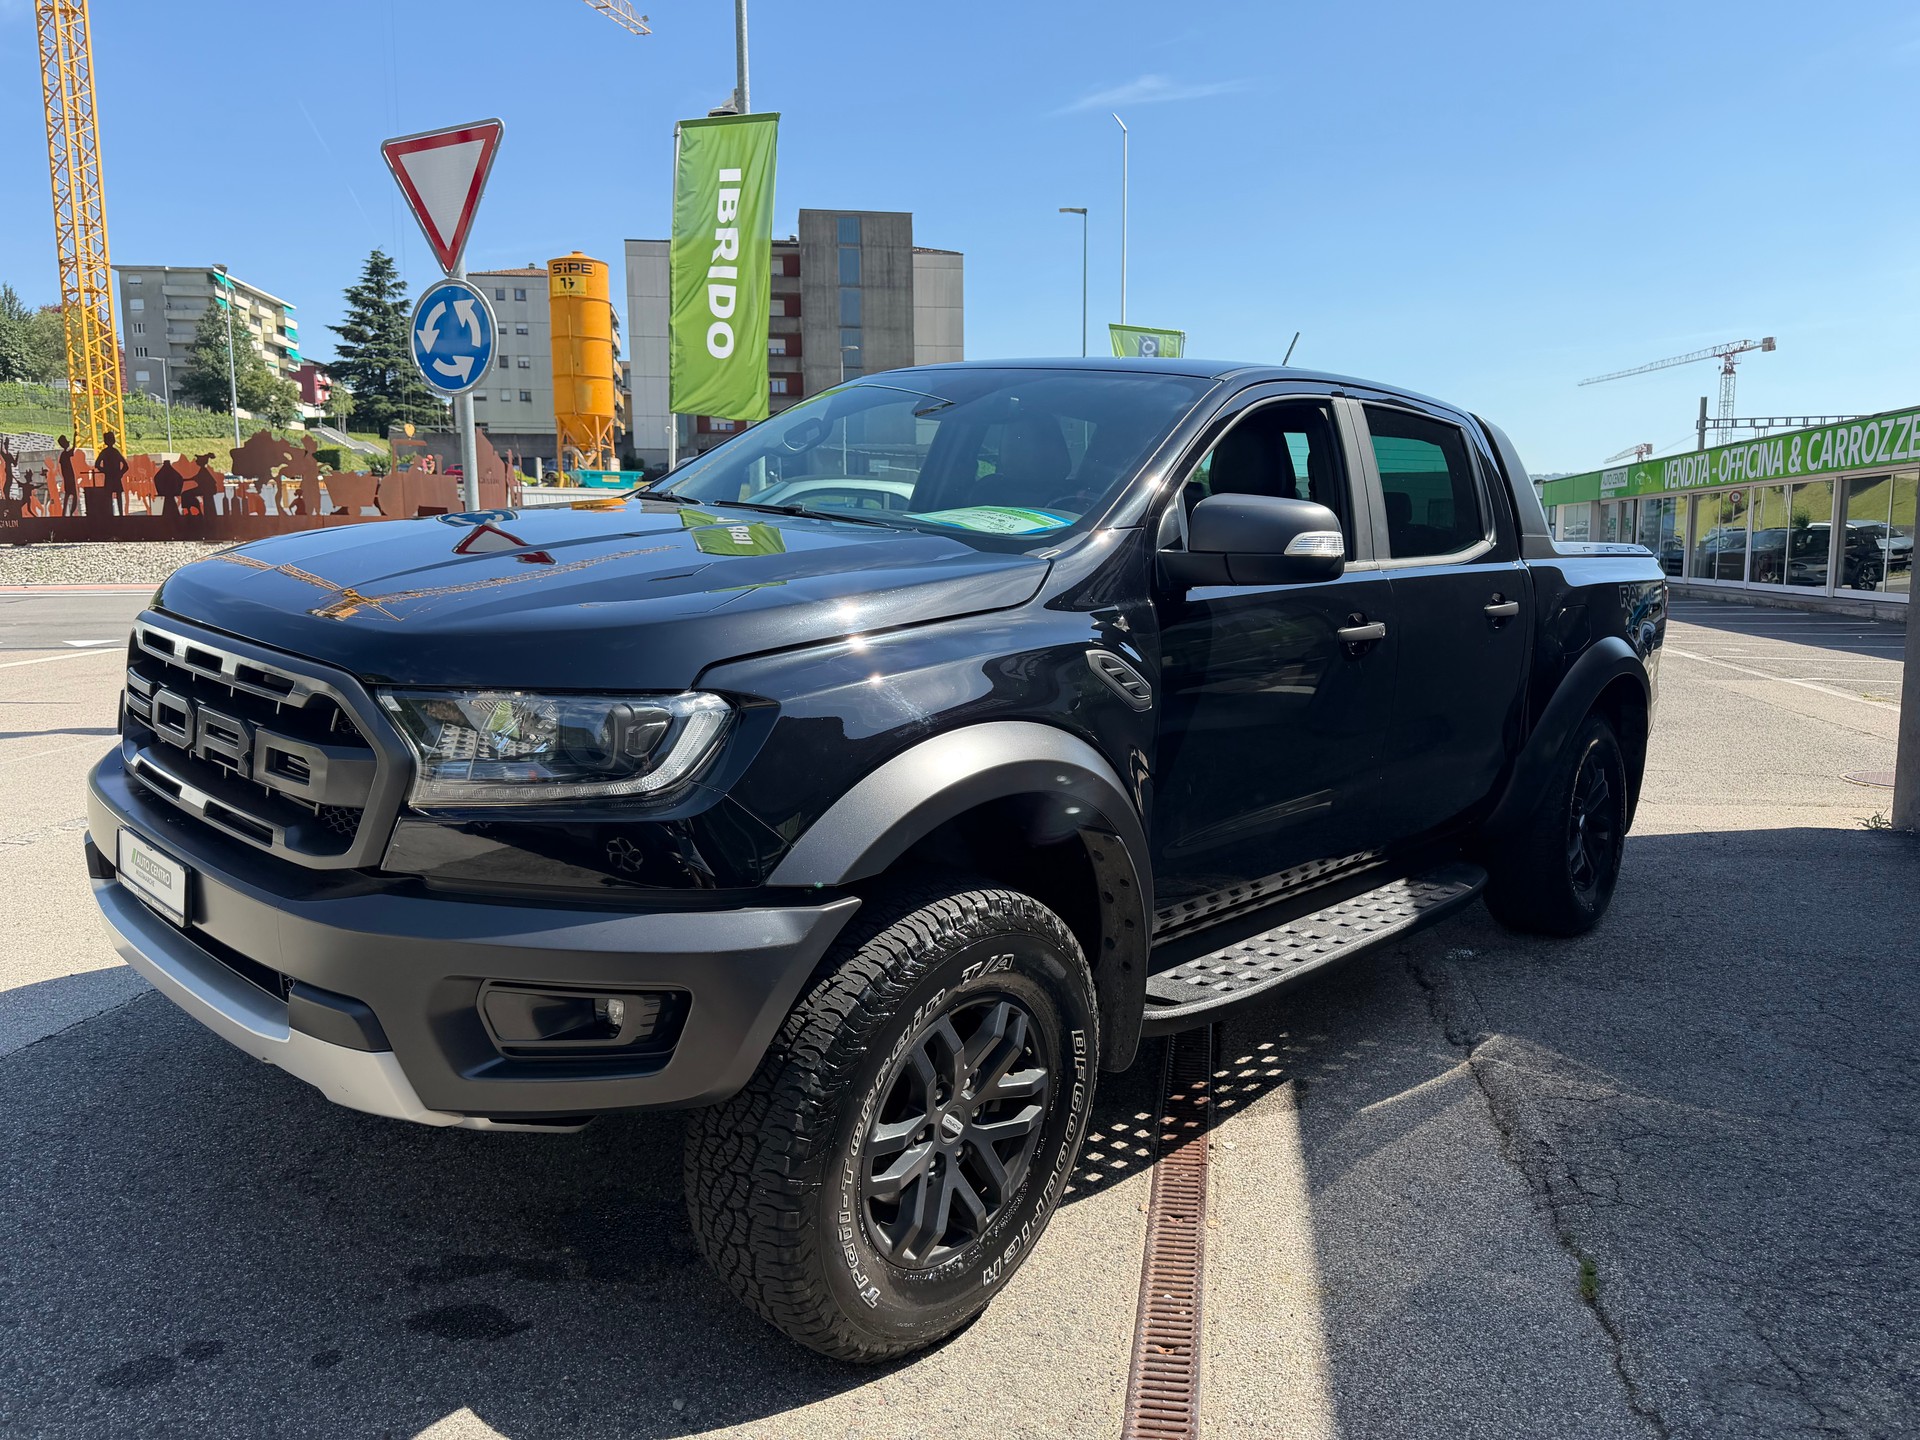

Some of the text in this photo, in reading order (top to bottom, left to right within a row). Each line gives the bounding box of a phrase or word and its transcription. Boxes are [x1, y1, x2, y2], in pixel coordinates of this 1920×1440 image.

[706, 168, 742, 359] IBRIDO
[1664, 453, 1711, 489] VENDITA
[1718, 440, 1784, 483] OFFICINA
[1787, 436, 1802, 473] &
[1806, 413, 1920, 472] CARROZZE
[136, 853, 170, 885] AUTO CENTRO
[961, 953, 1016, 986] T/A
